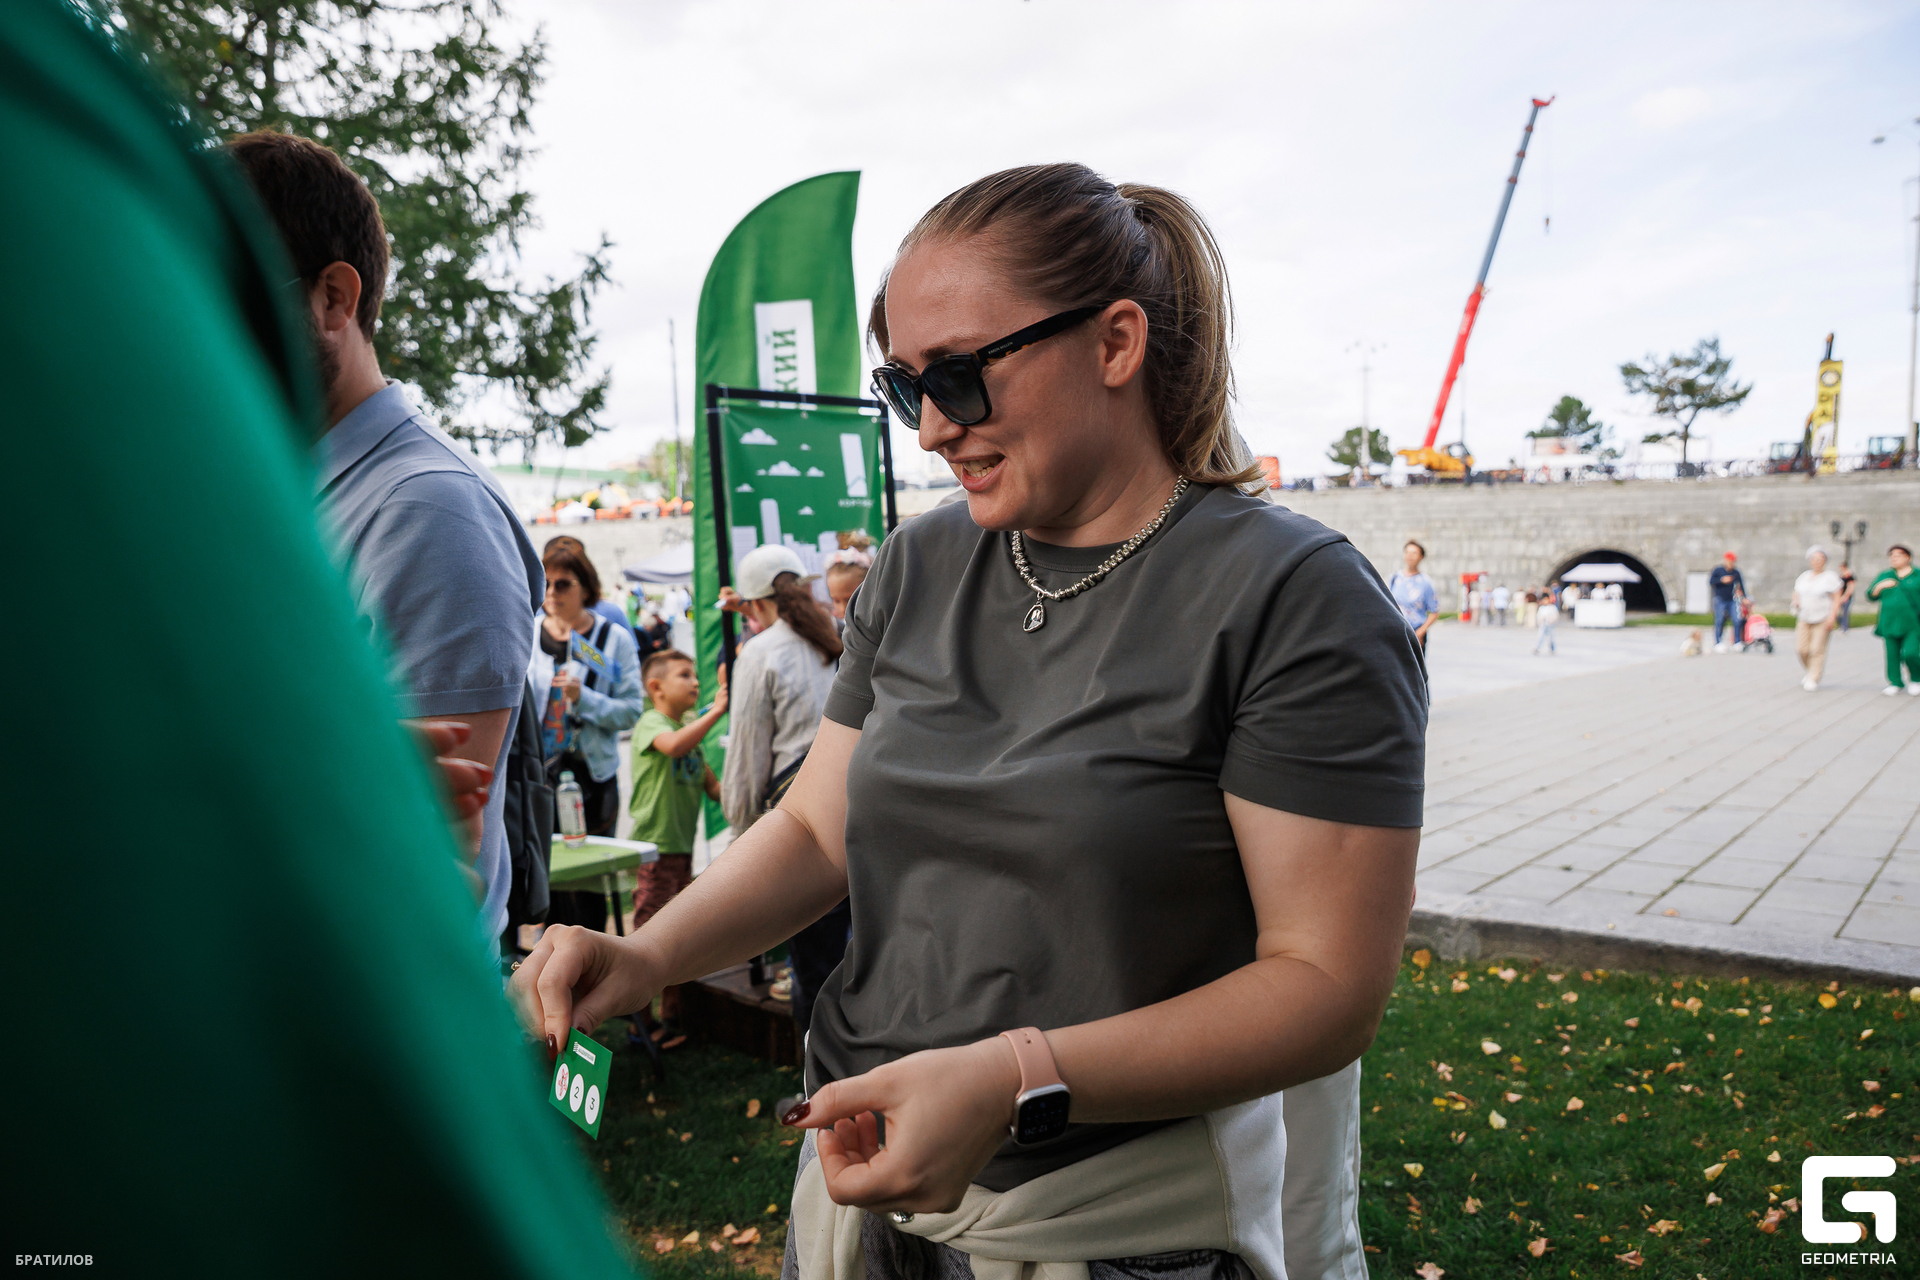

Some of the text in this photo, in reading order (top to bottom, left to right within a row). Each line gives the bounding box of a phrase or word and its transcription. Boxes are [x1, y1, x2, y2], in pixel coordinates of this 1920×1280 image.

[765, 329, 798, 404] КИЙ
[574, 1086, 580, 1099] 2
[589, 1097, 595, 1111] 3
